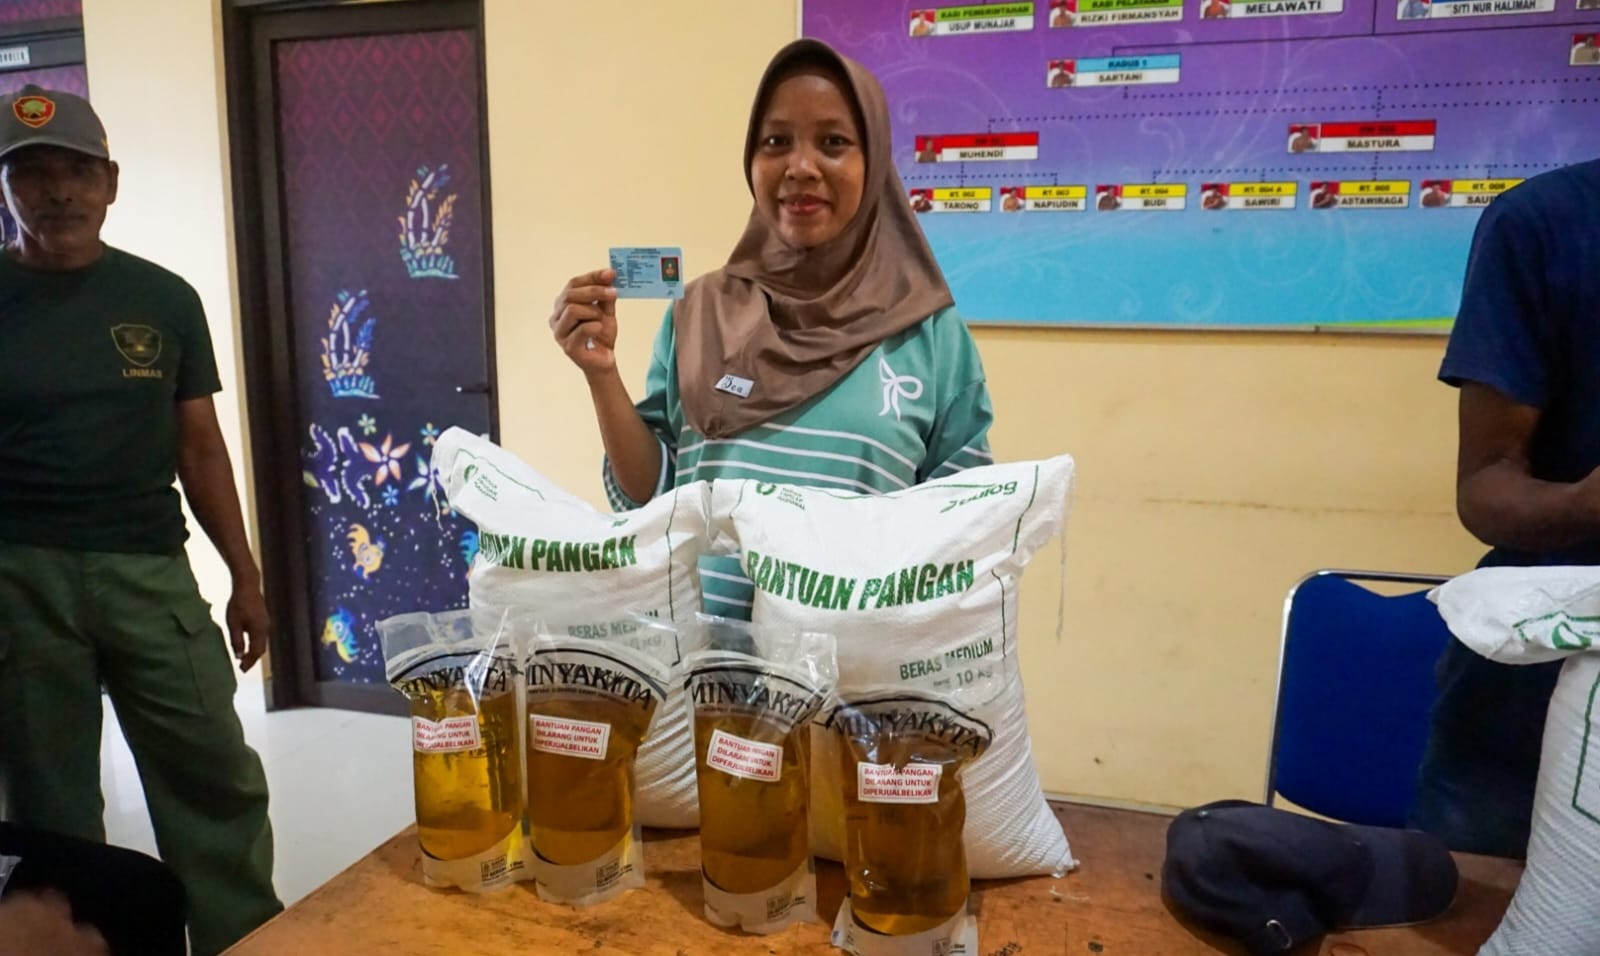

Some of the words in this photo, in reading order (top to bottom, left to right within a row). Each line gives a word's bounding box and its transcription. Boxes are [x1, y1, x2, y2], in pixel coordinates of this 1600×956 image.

[1246, 1, 1322, 13] MELAWATI
[1453, 4, 1471, 14] SITI
[1472, 2, 1492, 12] NUR
[1494, 0, 1536, 11] HALIMAH
[1081, 13, 1108, 22] RIZKI
[1111, 10, 1179, 20] FIRMANSYAH
[974, 19, 1015, 29] MUNAJAR
[1347, 139, 1400, 148] MASTURA
[960, 149, 1004, 158] MUHENDI
[1143, 199, 1166, 207] BUDI
[1466, 195, 1497, 205] SAU
[122, 368, 163, 379] LINMAS
[531, 534, 637, 572] PANGAN
[747, 550, 857, 611] BANTUAN
[858, 558, 975, 611] PANGAN
[900, 656, 942, 681] BERAS
[957, 669, 973, 686] 10
[445, 721, 472, 729] PANGAN
[535, 720, 570, 730] BANTUAN
[571, 725, 602, 735] PANGAN
[536, 729, 572, 740] DILARANG
[574, 734, 598, 744] UNTUK
[535, 738, 599, 753] DIPERJUALBELIKAN
[717, 746, 749, 761] DILARAN
[750, 757, 772, 767] NTUK
[901, 768, 934, 776] PANGAN
[865, 778, 903, 786] DILARANG
[863, 788, 933, 797] DIPERJUALBELIKAN
